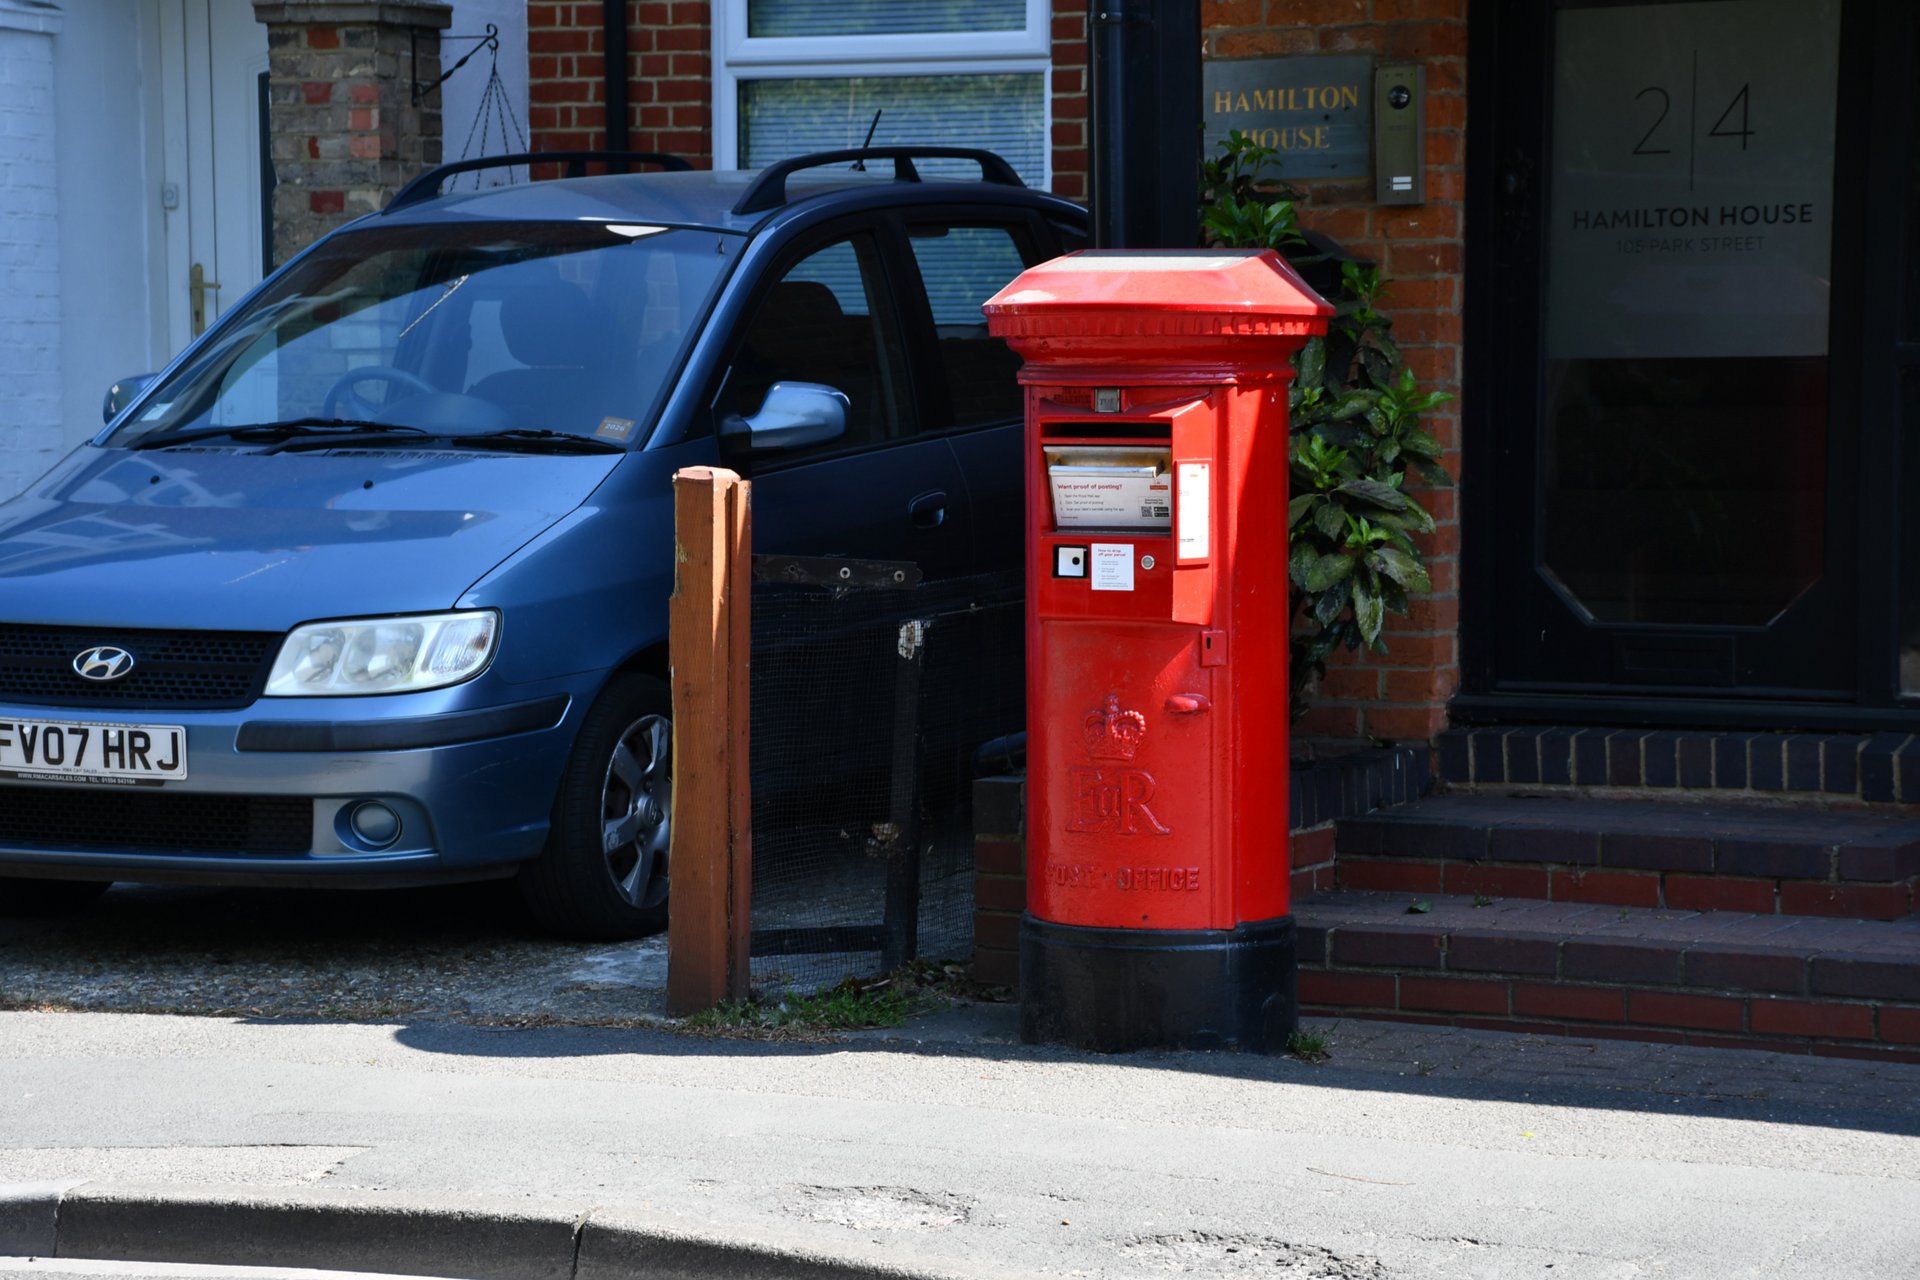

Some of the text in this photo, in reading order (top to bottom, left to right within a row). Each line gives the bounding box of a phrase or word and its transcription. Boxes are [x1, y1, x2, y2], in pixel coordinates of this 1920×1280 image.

[1214, 85, 1359, 114] HAMILTON
[1240, 125, 1331, 151] HOUSE
[1572, 203, 1814, 230] HAMILTON HOUSE
[1616, 235, 1767, 255] 105 PARK STREET
[1073, 483, 1089, 491] proof
[1098, 483, 1123, 491] posting?
[0, 723, 178, 771] FV07 HRJ
[17, 772, 87, 783] WWW.RMACARSALES.COM
[1116, 866, 1201, 892] OFFICE
